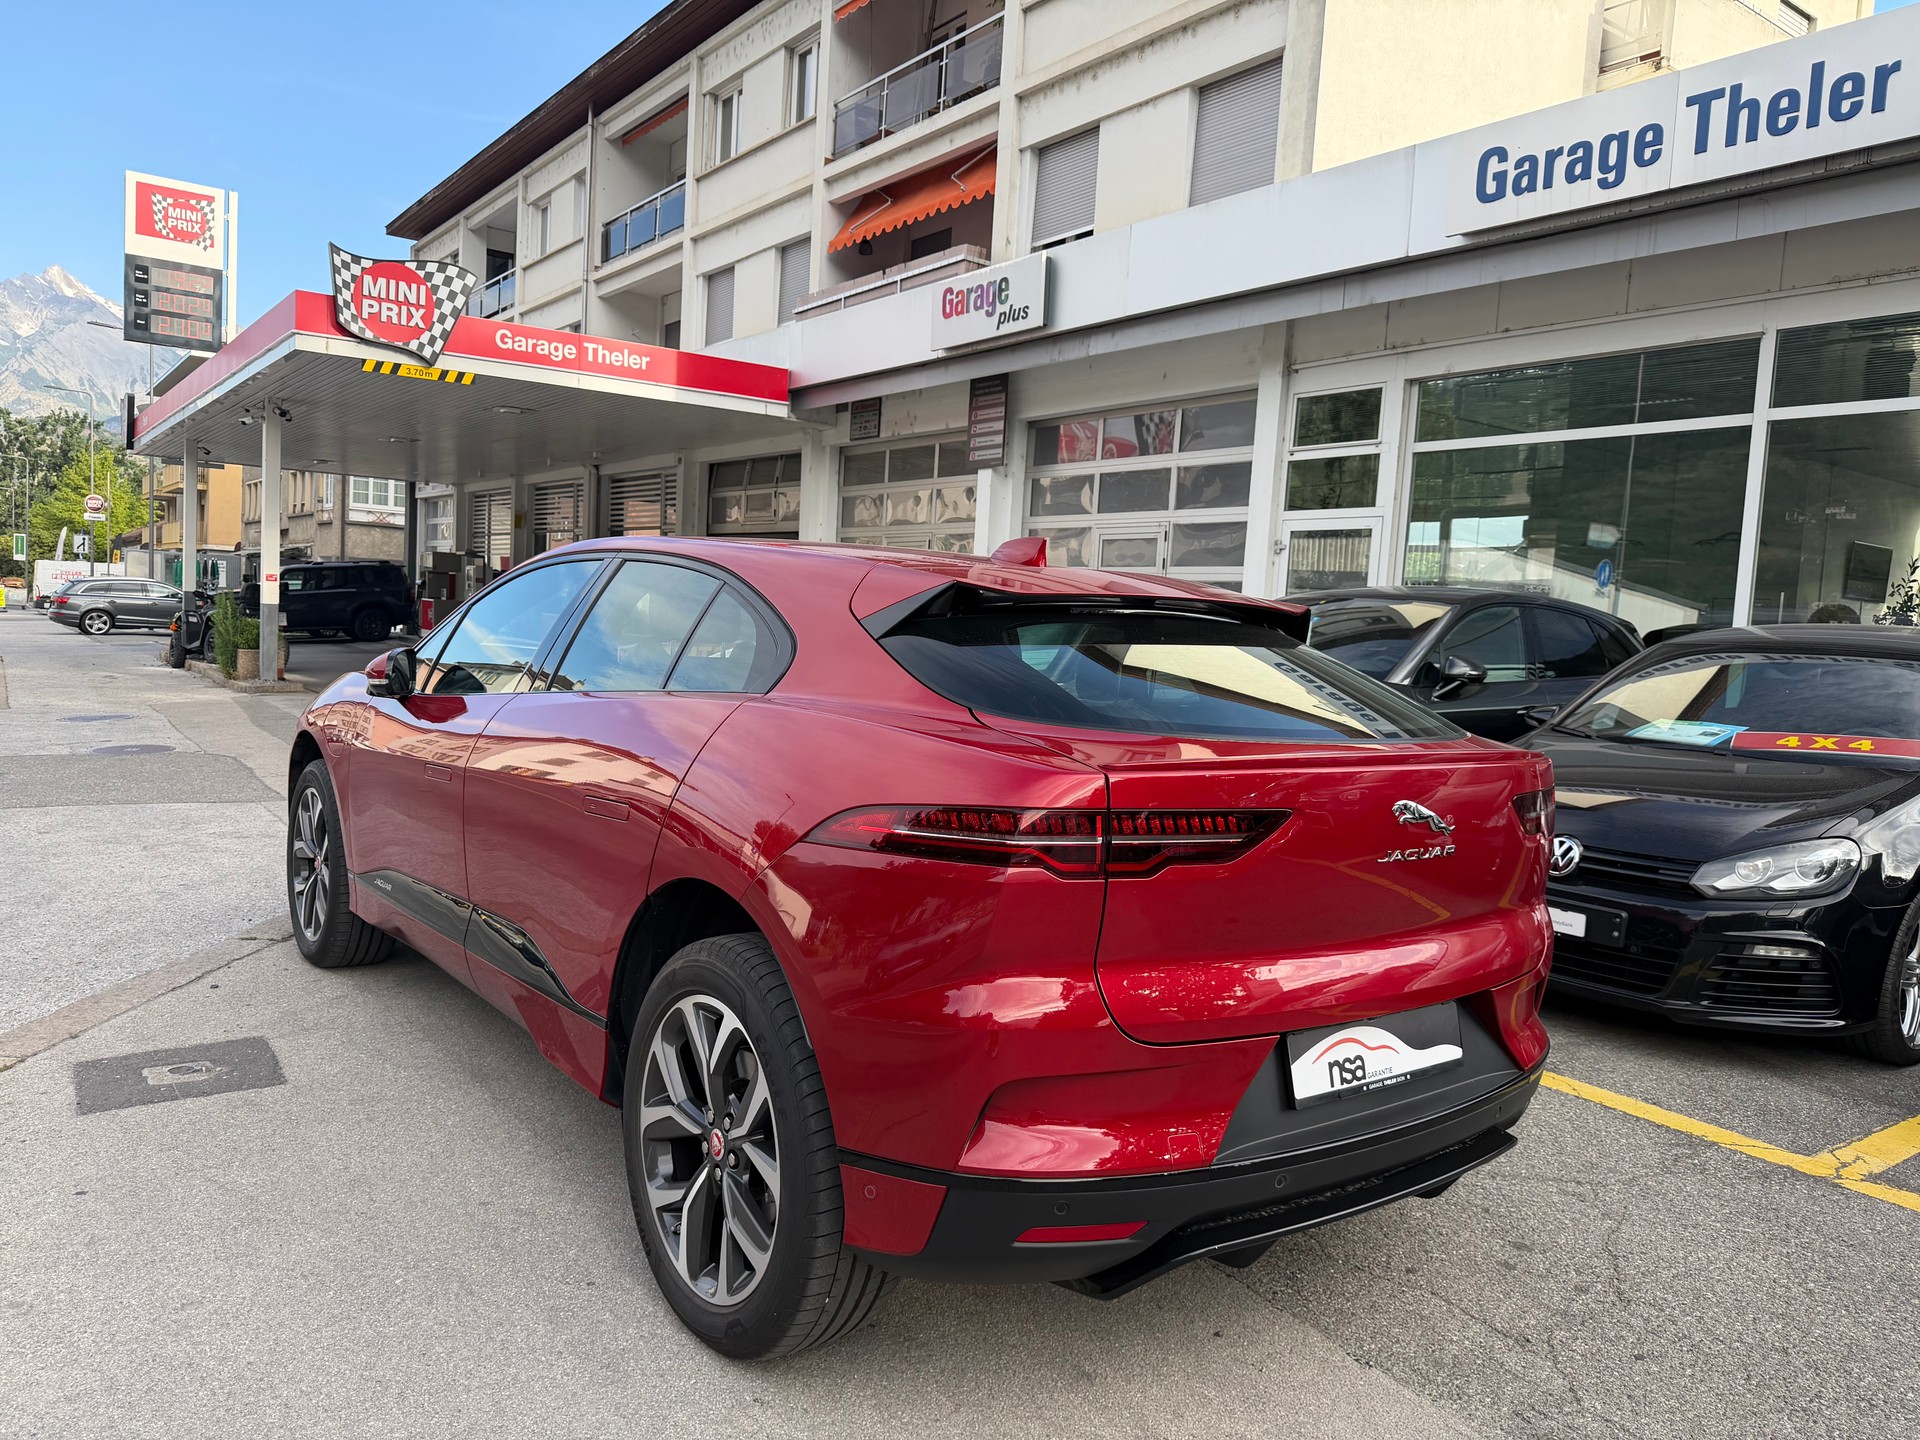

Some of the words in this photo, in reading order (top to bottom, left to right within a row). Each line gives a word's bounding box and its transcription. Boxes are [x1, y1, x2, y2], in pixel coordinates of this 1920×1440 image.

[1475, 122, 1664, 204] Garage
[1685, 59, 1902, 155] Theler
[168, 206, 202, 222] MINI
[168, 219, 202, 234] PRIX
[361, 274, 427, 306] MINI
[942, 276, 1010, 319] Garage
[361, 298, 427, 330] PRIX
[997, 304, 1029, 330] plus
[495, 328, 577, 360] Garage
[584, 343, 651, 371] Theler
[1377, 844, 1456, 862] JAGUAR
[374, 877, 393, 891] JAGUAR
[1328, 1054, 1367, 1088] nsa
[1367, 1066, 1393, 1079] GARANTIE
